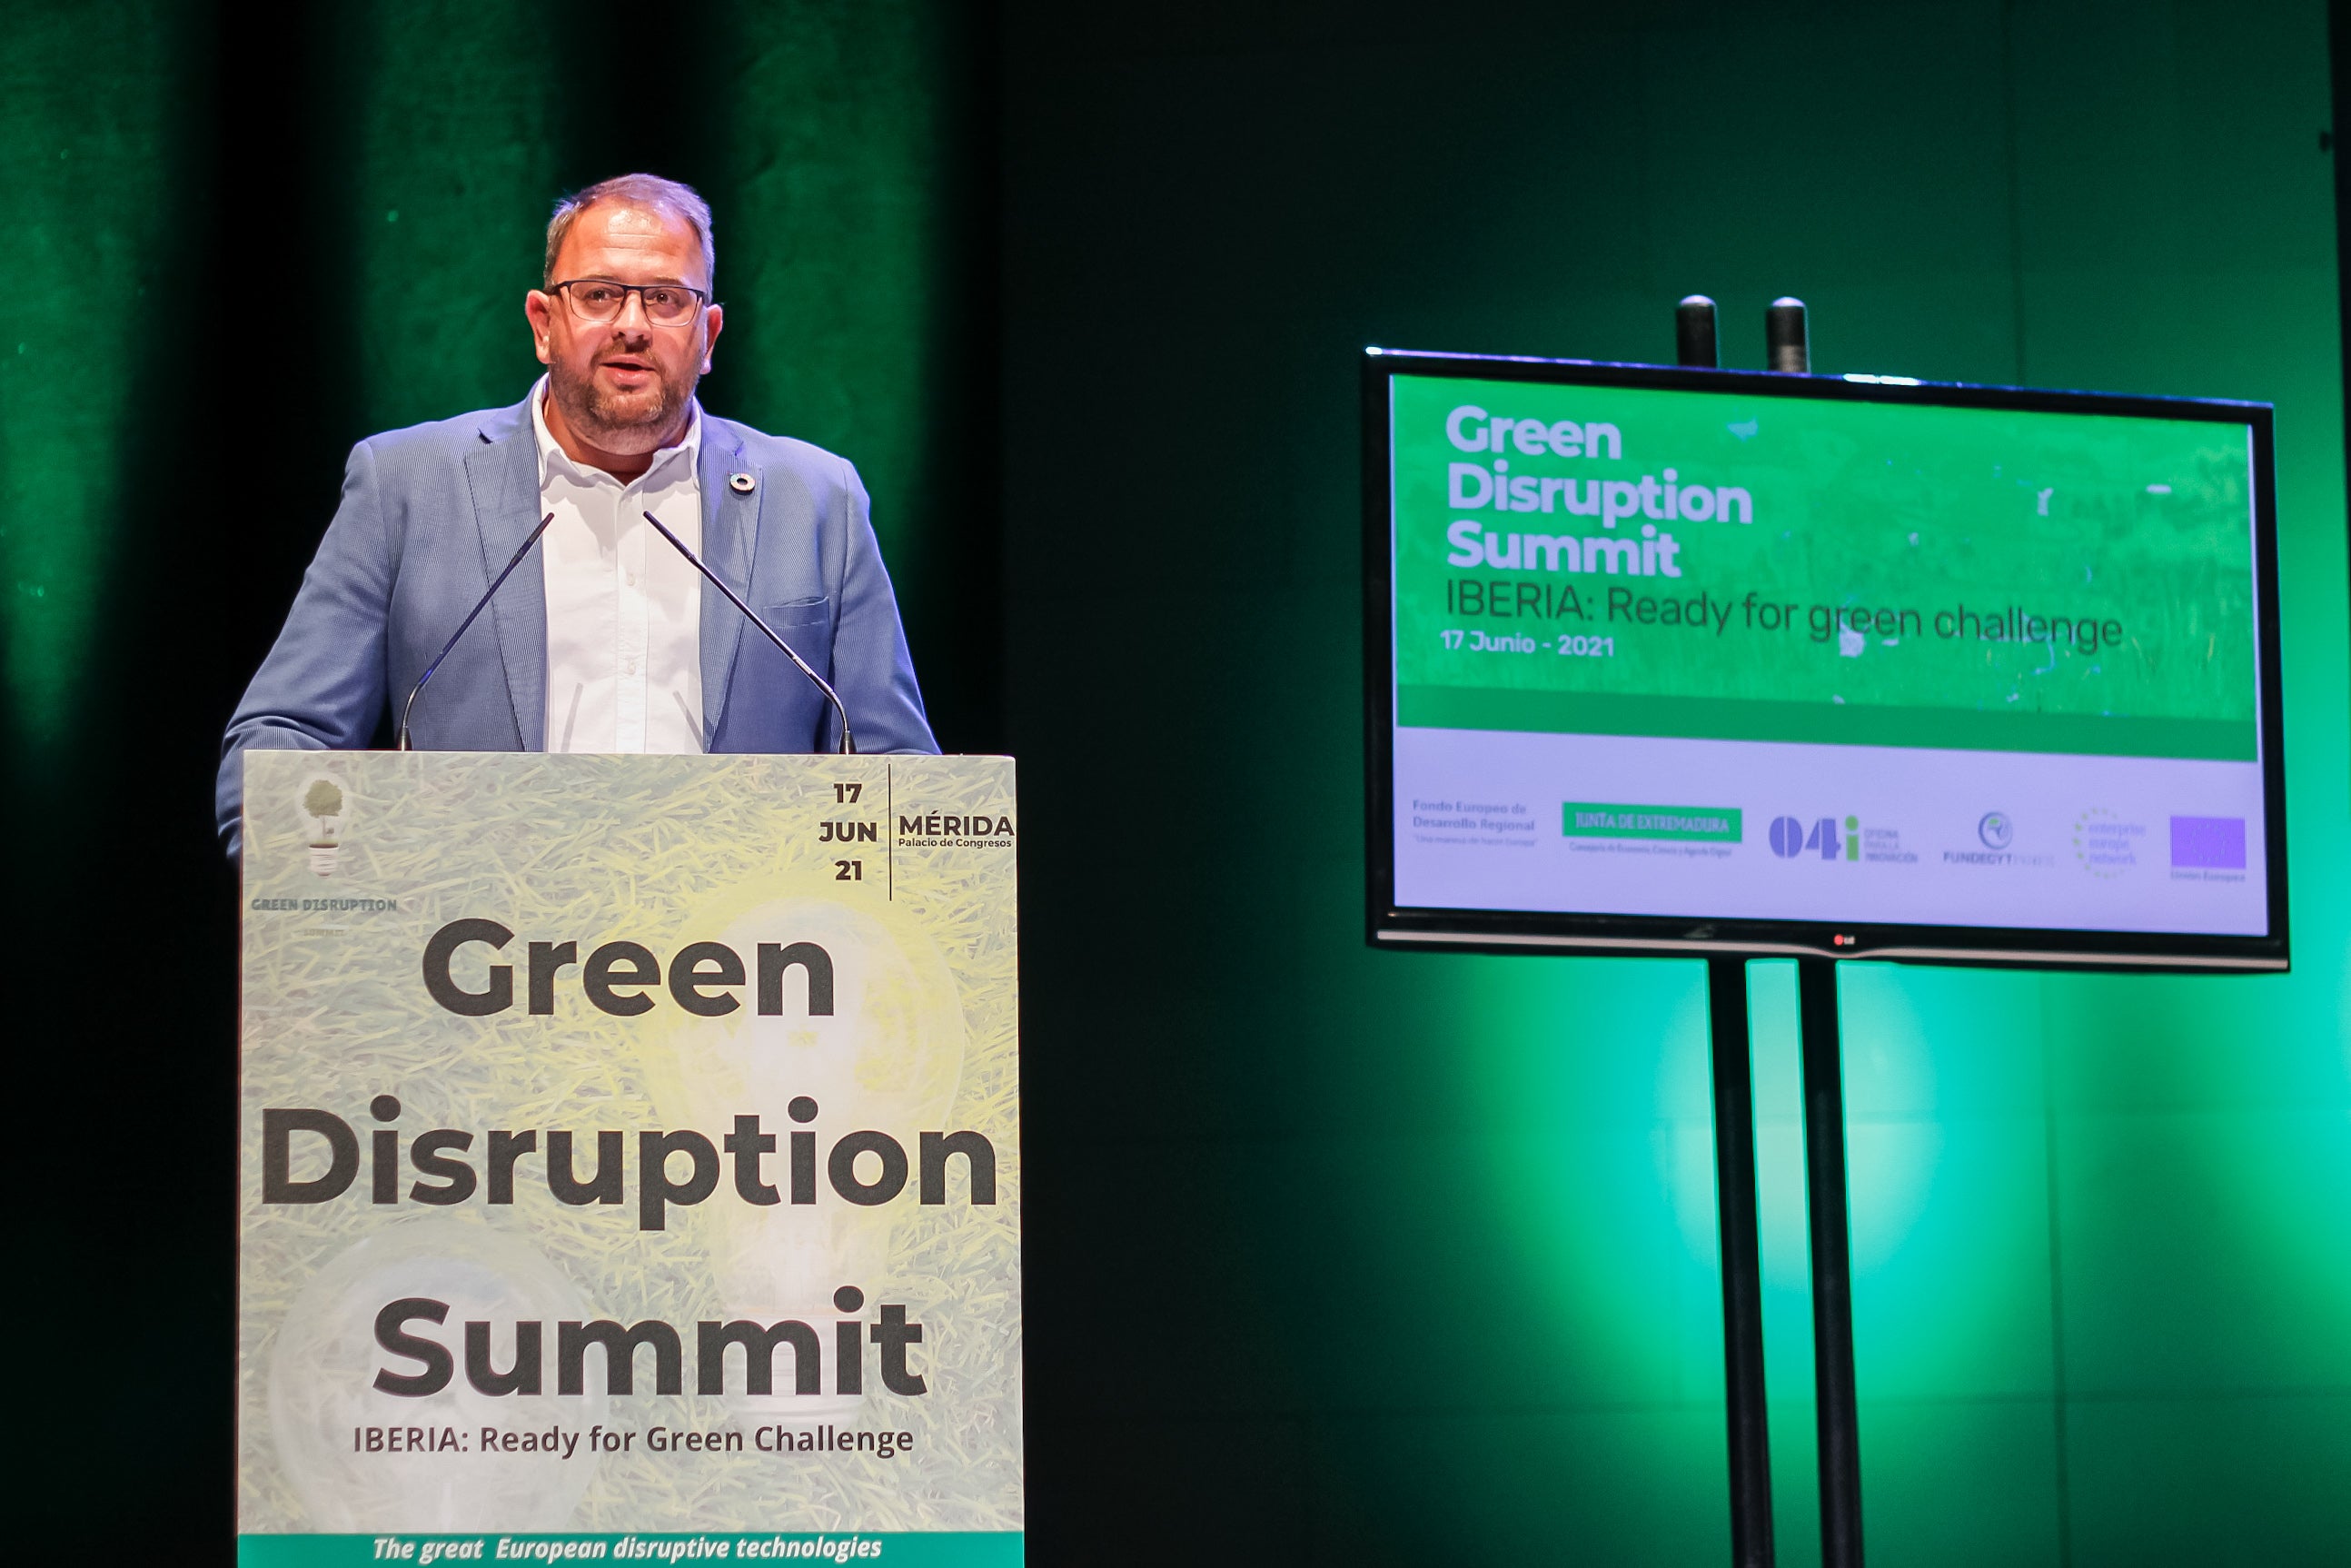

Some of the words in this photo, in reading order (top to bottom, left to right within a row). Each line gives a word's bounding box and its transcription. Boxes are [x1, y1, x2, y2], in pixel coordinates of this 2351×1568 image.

[1445, 404, 1622, 460] Green
[1448, 459, 1753, 529] Disruption
[1446, 520, 1681, 578] Summit
[1447, 579, 1593, 621] IBERIA:
[1607, 587, 1732, 636] Ready
[1741, 592, 1799, 631] for
[1809, 604, 1921, 644] green
[1934, 603, 2123, 655] challenge
[1440, 630, 1464, 650] 17
[1470, 630, 1536, 653] Junio
[1557, 634, 1614, 657] 2021
[833, 783, 862, 804] 17
[1413, 799, 1453, 812] Fondo
[1455, 800, 1509, 815] Europeo
[1511, 803, 1526, 815] de
[818, 821, 878, 842] JUN
[899, 809, 1016, 836] MÉRIDA
[1413, 816, 1477, 829] Desarrollo
[1480, 819, 1535, 833] Regional
[1574, 811, 1616, 829] JUNTA
[1618, 813, 1635, 829] DE
[1637, 814, 1731, 833] EXTREMADURA
[898, 838, 937, 848] Palacio
[939, 838, 953, 848] de
[956, 839, 1012, 849] Congresos
[834, 859, 862, 881] 21
[252, 898, 298, 910] GREEN
[303, 898, 398, 911] DISRUPTION
[422, 918, 834, 1017] Green
[263, 1095, 997, 1231] Disruption
[372, 1285, 928, 1397] Summit
[353, 1426, 469, 1453] IBERIA:
[481, 1425, 580, 1460] Ready
[590, 1425, 636, 1453] for
[647, 1426, 743, 1453] Green
[755, 1424, 914, 1459] Challenge
[372, 1538, 413, 1560] The
[418, 1539, 484, 1564] great
[496, 1539, 607, 1563] European
[613, 1537, 729, 1563] disruptive
[736, 1536, 882, 1563] technologies
